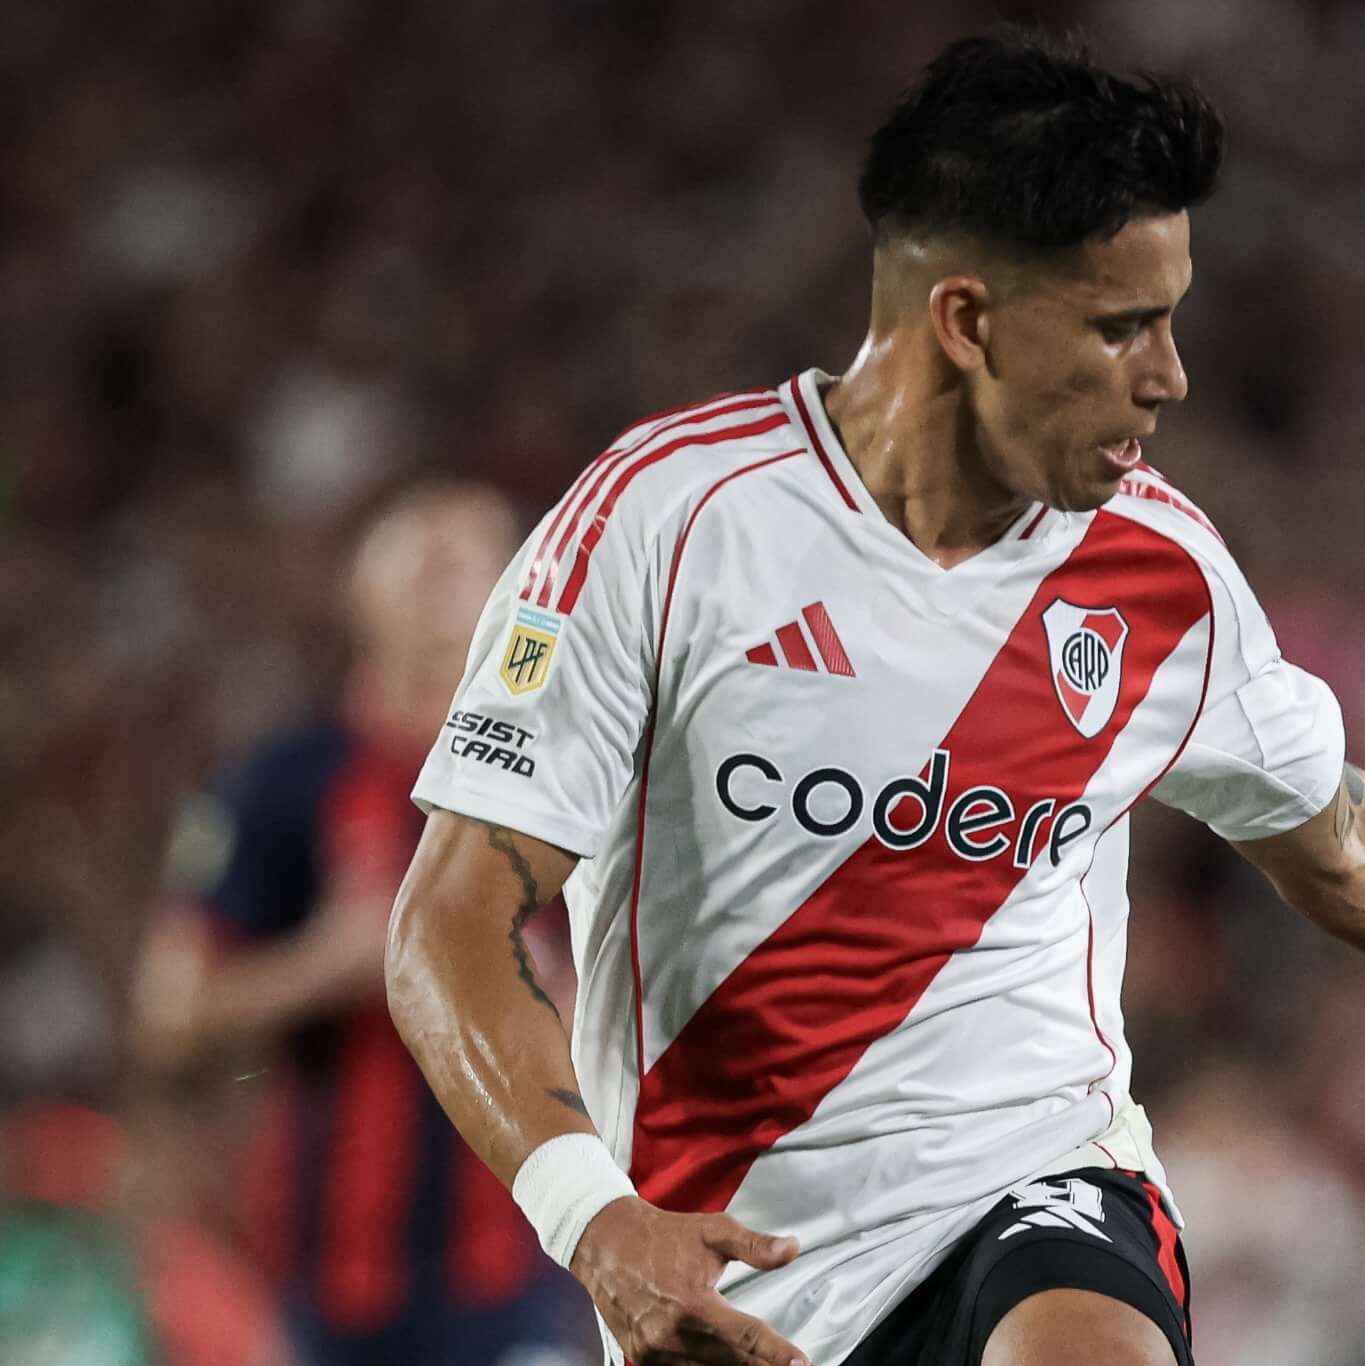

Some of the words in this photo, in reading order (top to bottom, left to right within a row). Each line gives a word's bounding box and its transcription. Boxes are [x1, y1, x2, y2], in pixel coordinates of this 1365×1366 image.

[507, 634, 549, 684] LPF
[1061, 630, 1110, 691] CARP
[450, 735, 537, 778] CARD
[715, 748, 1092, 869] codere
